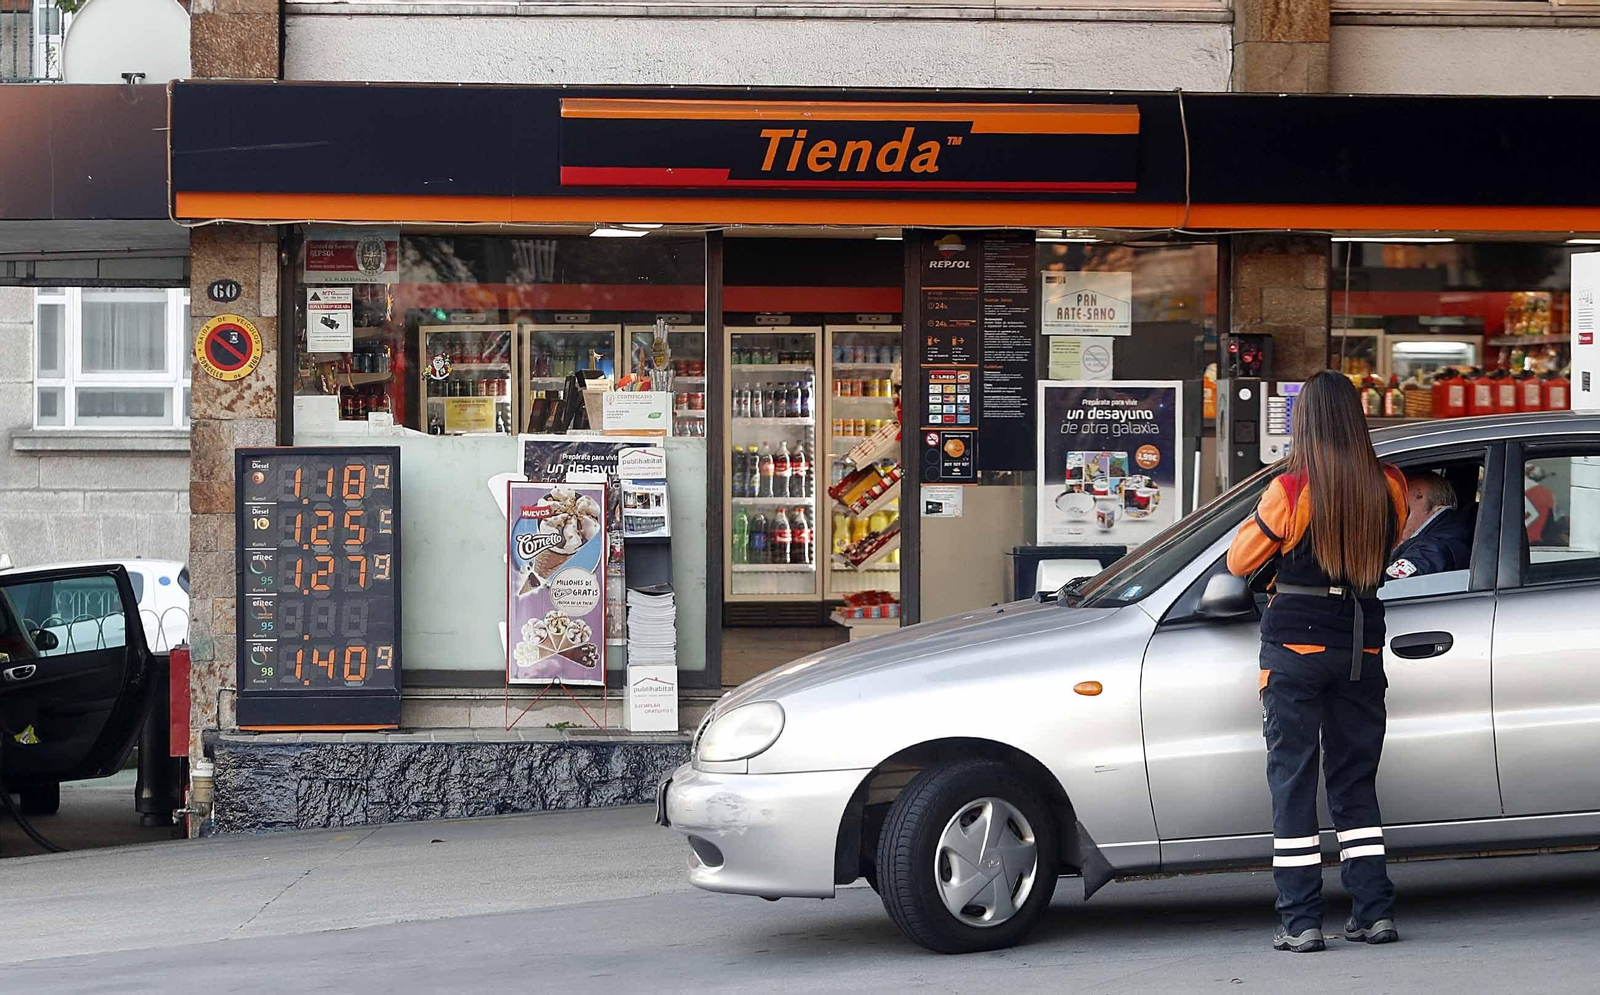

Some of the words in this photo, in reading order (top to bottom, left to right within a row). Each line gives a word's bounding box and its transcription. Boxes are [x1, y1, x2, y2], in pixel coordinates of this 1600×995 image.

[929, 260, 971, 269] REPSOL
[212, 284, 237, 299] 60
[1077, 294, 1097, 306] PAN
[1057, 307, 1115, 320] ARTE-SANO
[199, 356, 224, 379] CONCELLO
[248, 356, 260, 369] VIGO
[1082, 398, 1110, 407] Prepárate
[1126, 398, 1138, 406] vivir
[1066, 409, 1084, 420] un
[1087, 406, 1154, 423] desayuno
[1060, 421, 1078, 434] de
[1081, 422, 1108, 434] otra
[1112, 421, 1160, 437] galaxia
[562, 453, 590, 462] Prepárate
[622, 458, 662, 466] publihabitat
[546, 463, 564, 474] un
[568, 462, 619, 475] desayu
[522, 509, 550, 517] NUEVOS
[252, 517, 270, 530] 10
[516, 533, 562, 560] Cornetto
[261, 576, 273, 585] 95
[261, 622, 274, 630] 95
[261, 667, 274, 676] 98
